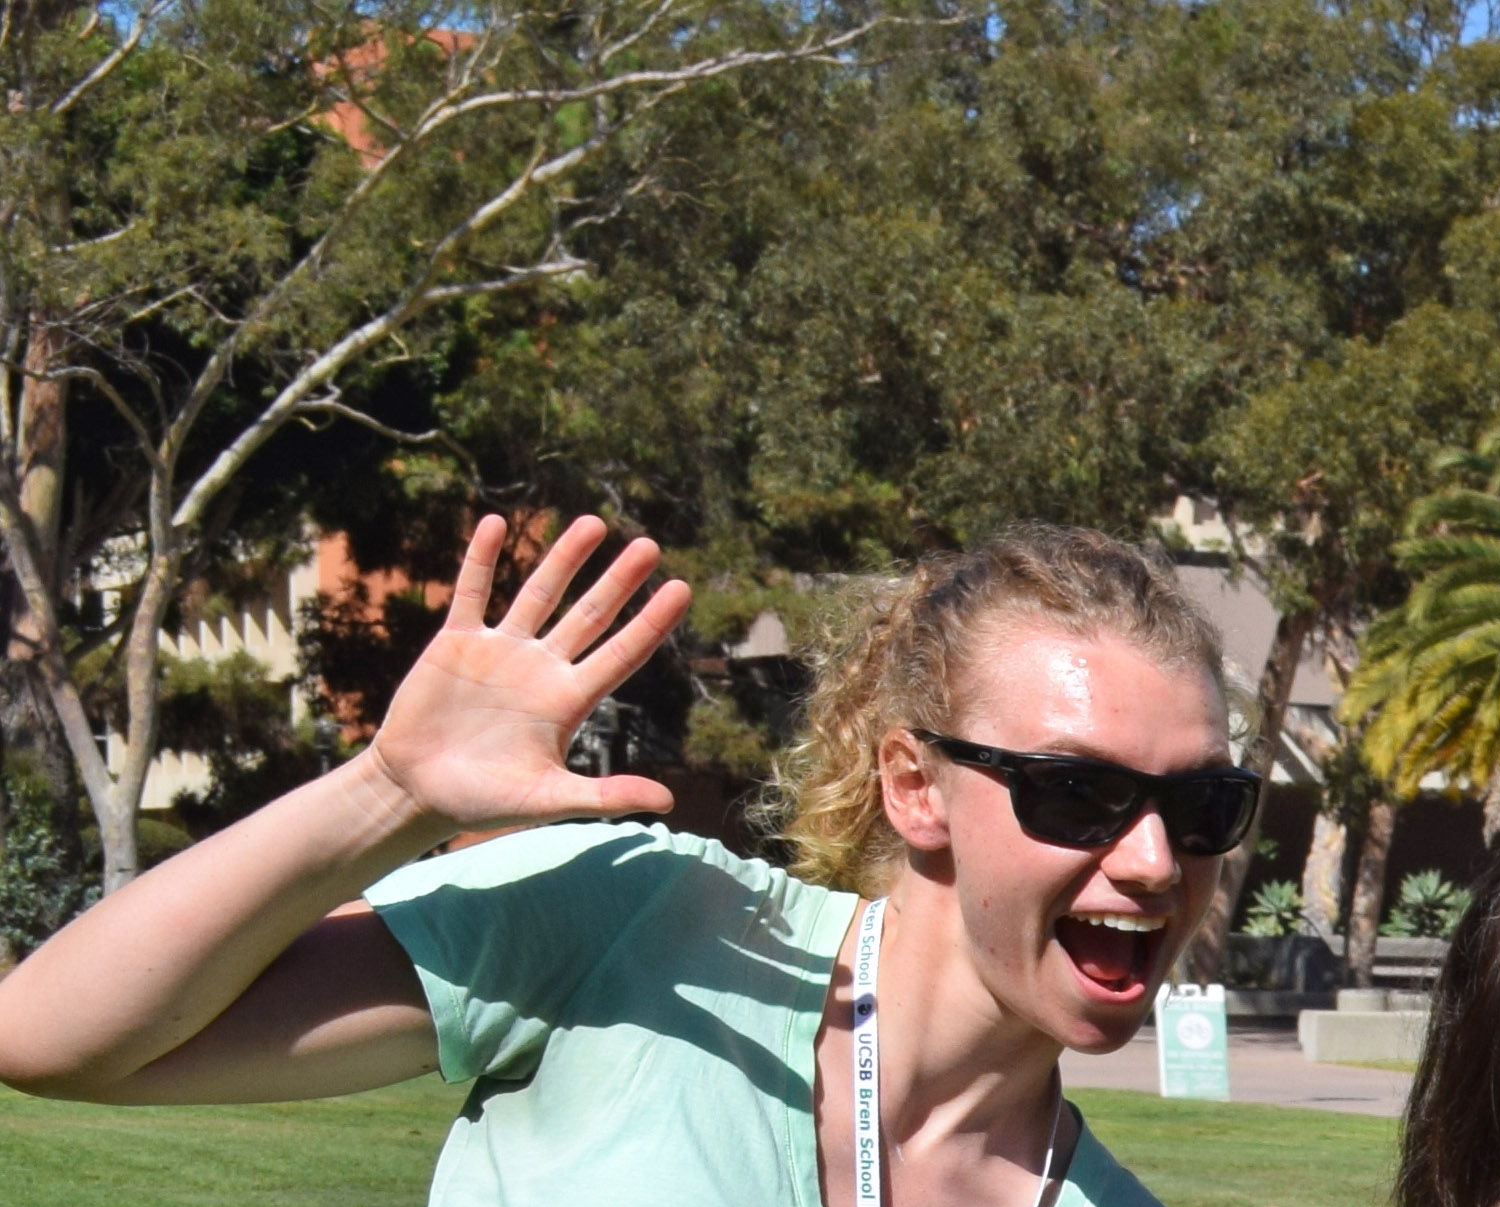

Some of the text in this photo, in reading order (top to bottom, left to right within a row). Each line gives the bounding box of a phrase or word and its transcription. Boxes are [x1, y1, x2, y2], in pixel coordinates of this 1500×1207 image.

[857, 935, 876, 986] School
[858, 1033, 875, 1199] UCSB Bren School
